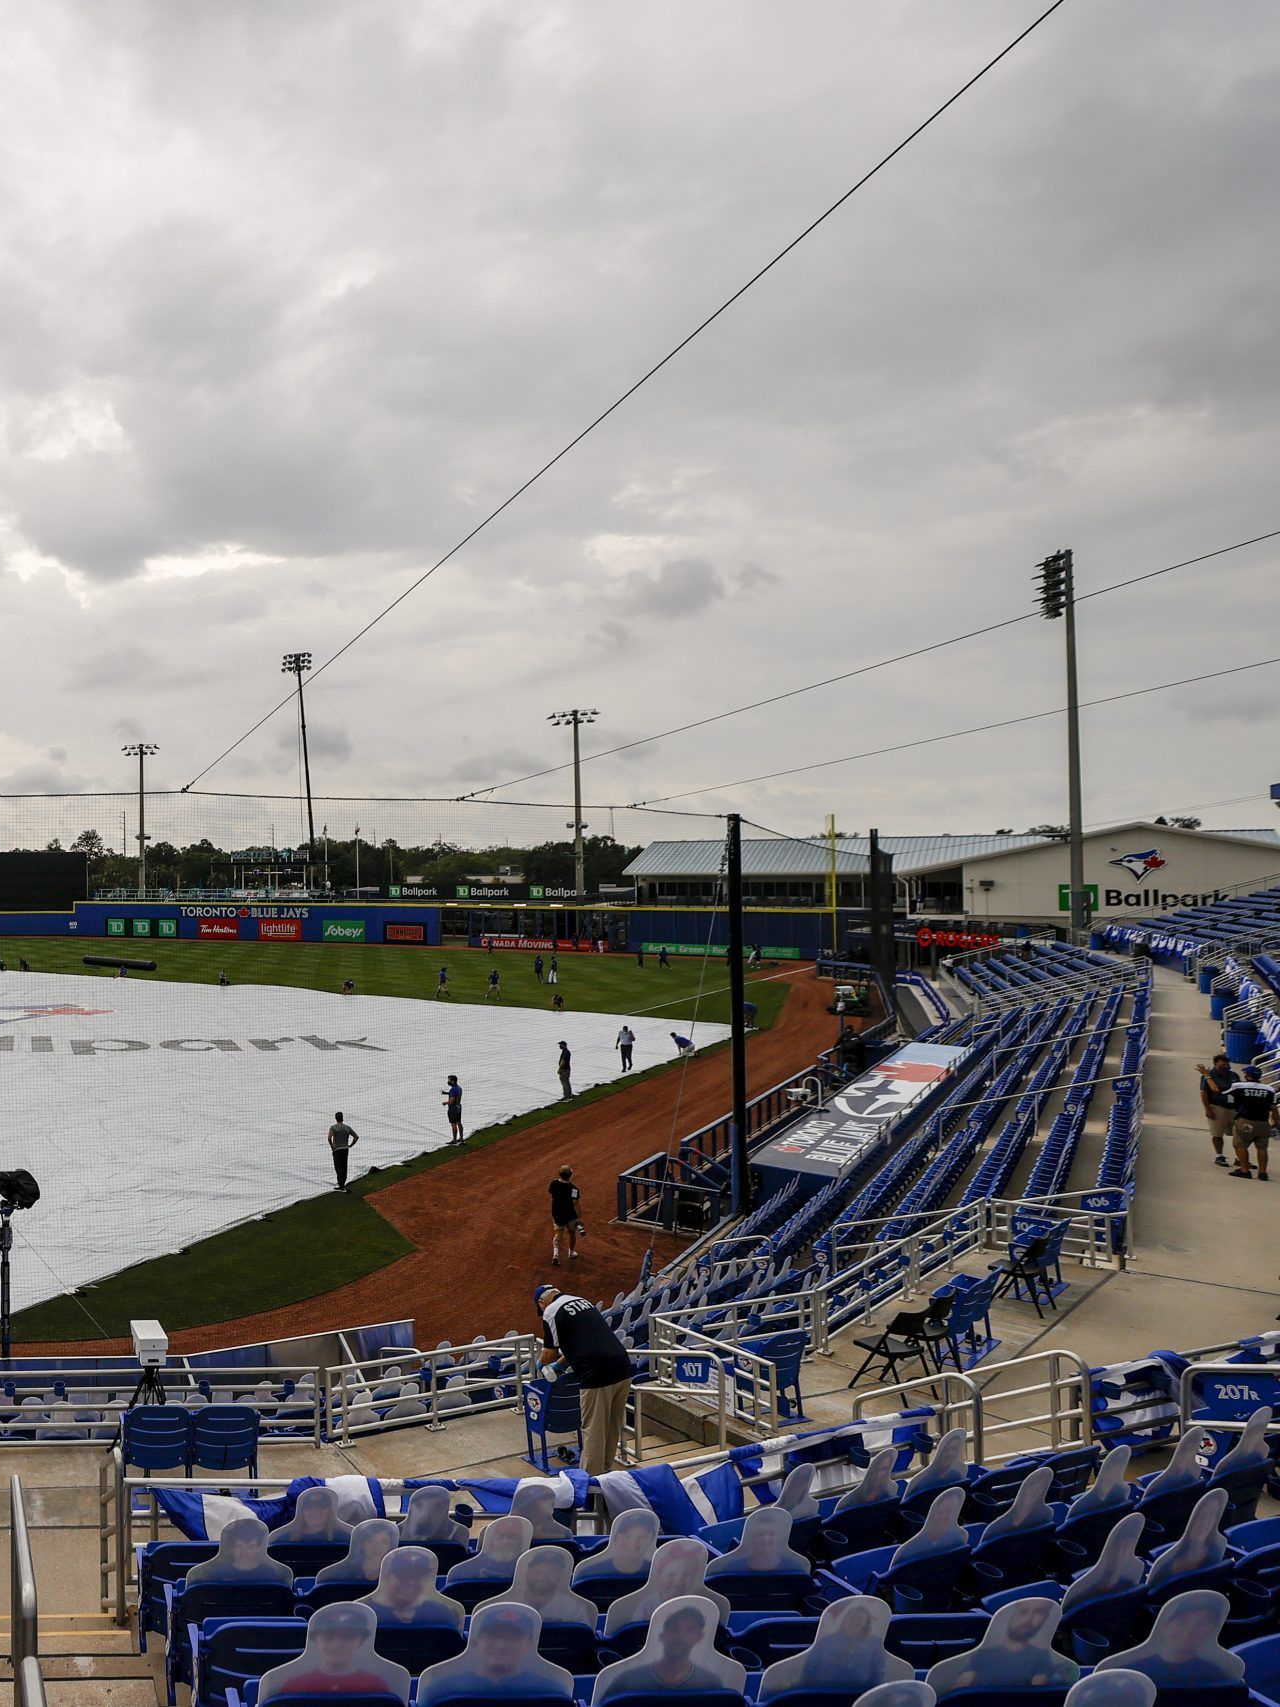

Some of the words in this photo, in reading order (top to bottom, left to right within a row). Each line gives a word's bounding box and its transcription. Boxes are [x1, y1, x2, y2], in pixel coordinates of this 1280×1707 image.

[390, 887, 400, 895] TD
[402, 887, 438, 896] Ballpark
[458, 888, 469, 896] TD
[470, 887, 509, 897] Ballpark
[531, 888, 542, 896] TD
[1104, 889, 1229, 911] Ballpark
[180, 906, 237, 917] TORONTO
[251, 907, 278, 918] BLUE
[280, 907, 309, 918] JAYS
[109, 921, 123, 933] TD
[134, 921, 149, 933] TD
[160, 922, 174, 934] TD
[200, 924, 212, 933] Tim
[212, 925, 237, 934] Hortons
[324, 925, 363, 938] Sobeys
[481, 938, 516, 948] CNADA
[518, 939, 554, 949] MOVING
[935, 930, 1001, 949] ROGERS
[1116, 1080, 1131, 1088] 105
[1244, 1088, 1268, 1098] STAFF
[780, 1120, 837, 1148] TORONTO
[804, 1139, 863, 1164] BLUE
[1087, 1196, 1110, 1208] 106
[1015, 1221, 1034, 1232] 10
[682, 1362, 703, 1378] 107
[1214, 1384, 1261, 1401] 207R
